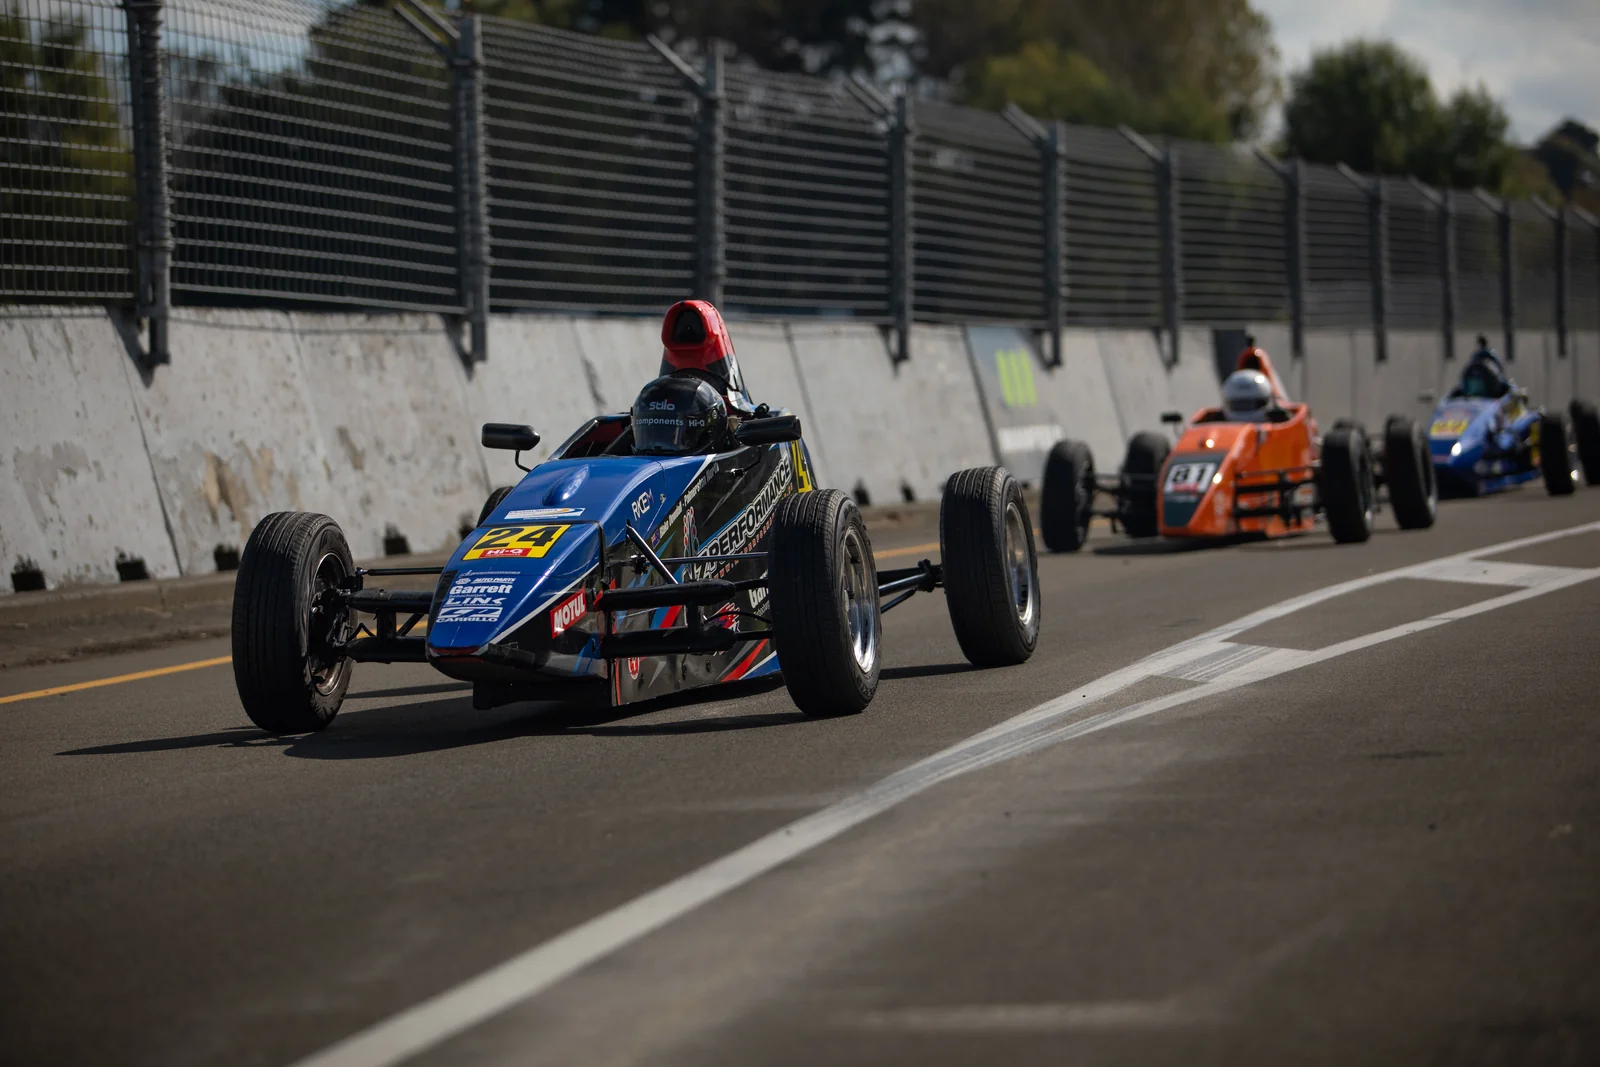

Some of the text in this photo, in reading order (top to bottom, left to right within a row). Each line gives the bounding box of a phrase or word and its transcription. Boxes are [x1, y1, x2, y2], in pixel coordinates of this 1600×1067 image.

[472, 525, 562, 551] 24
[450, 584, 513, 595] Garrett
[554, 593, 586, 633] MOTUL
